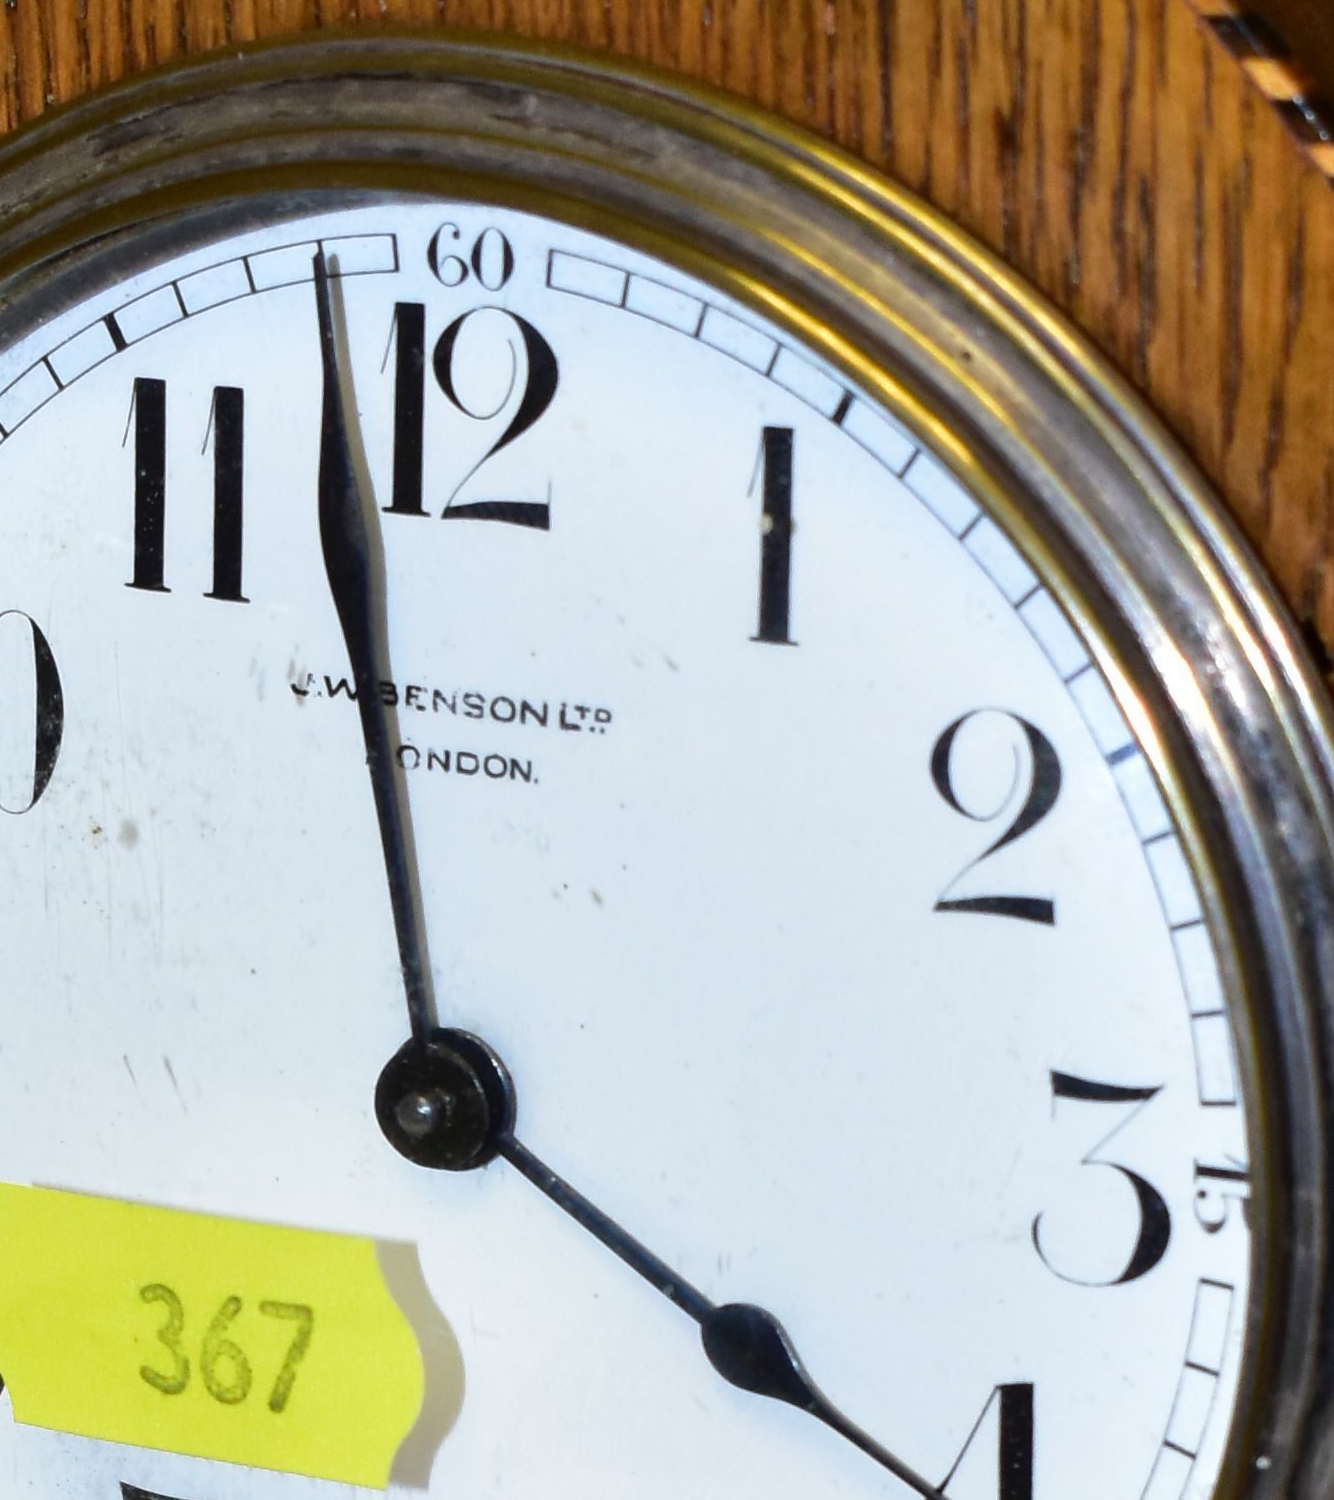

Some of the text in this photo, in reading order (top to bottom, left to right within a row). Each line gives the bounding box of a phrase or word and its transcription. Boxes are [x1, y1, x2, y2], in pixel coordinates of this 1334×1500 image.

[427, 222, 515, 292] 60
[121, 377, 251, 604] 11
[380, 301, 560, 531] 12
[748, 426, 799, 646] 1
[365, 744, 540, 785] ONDON.
[929, 707, 1062, 927] 2
[1032, 1068, 1173, 1288] 3
[1192, 1152, 1252, 1235] 15
[139, 1283, 315, 1414] 367
